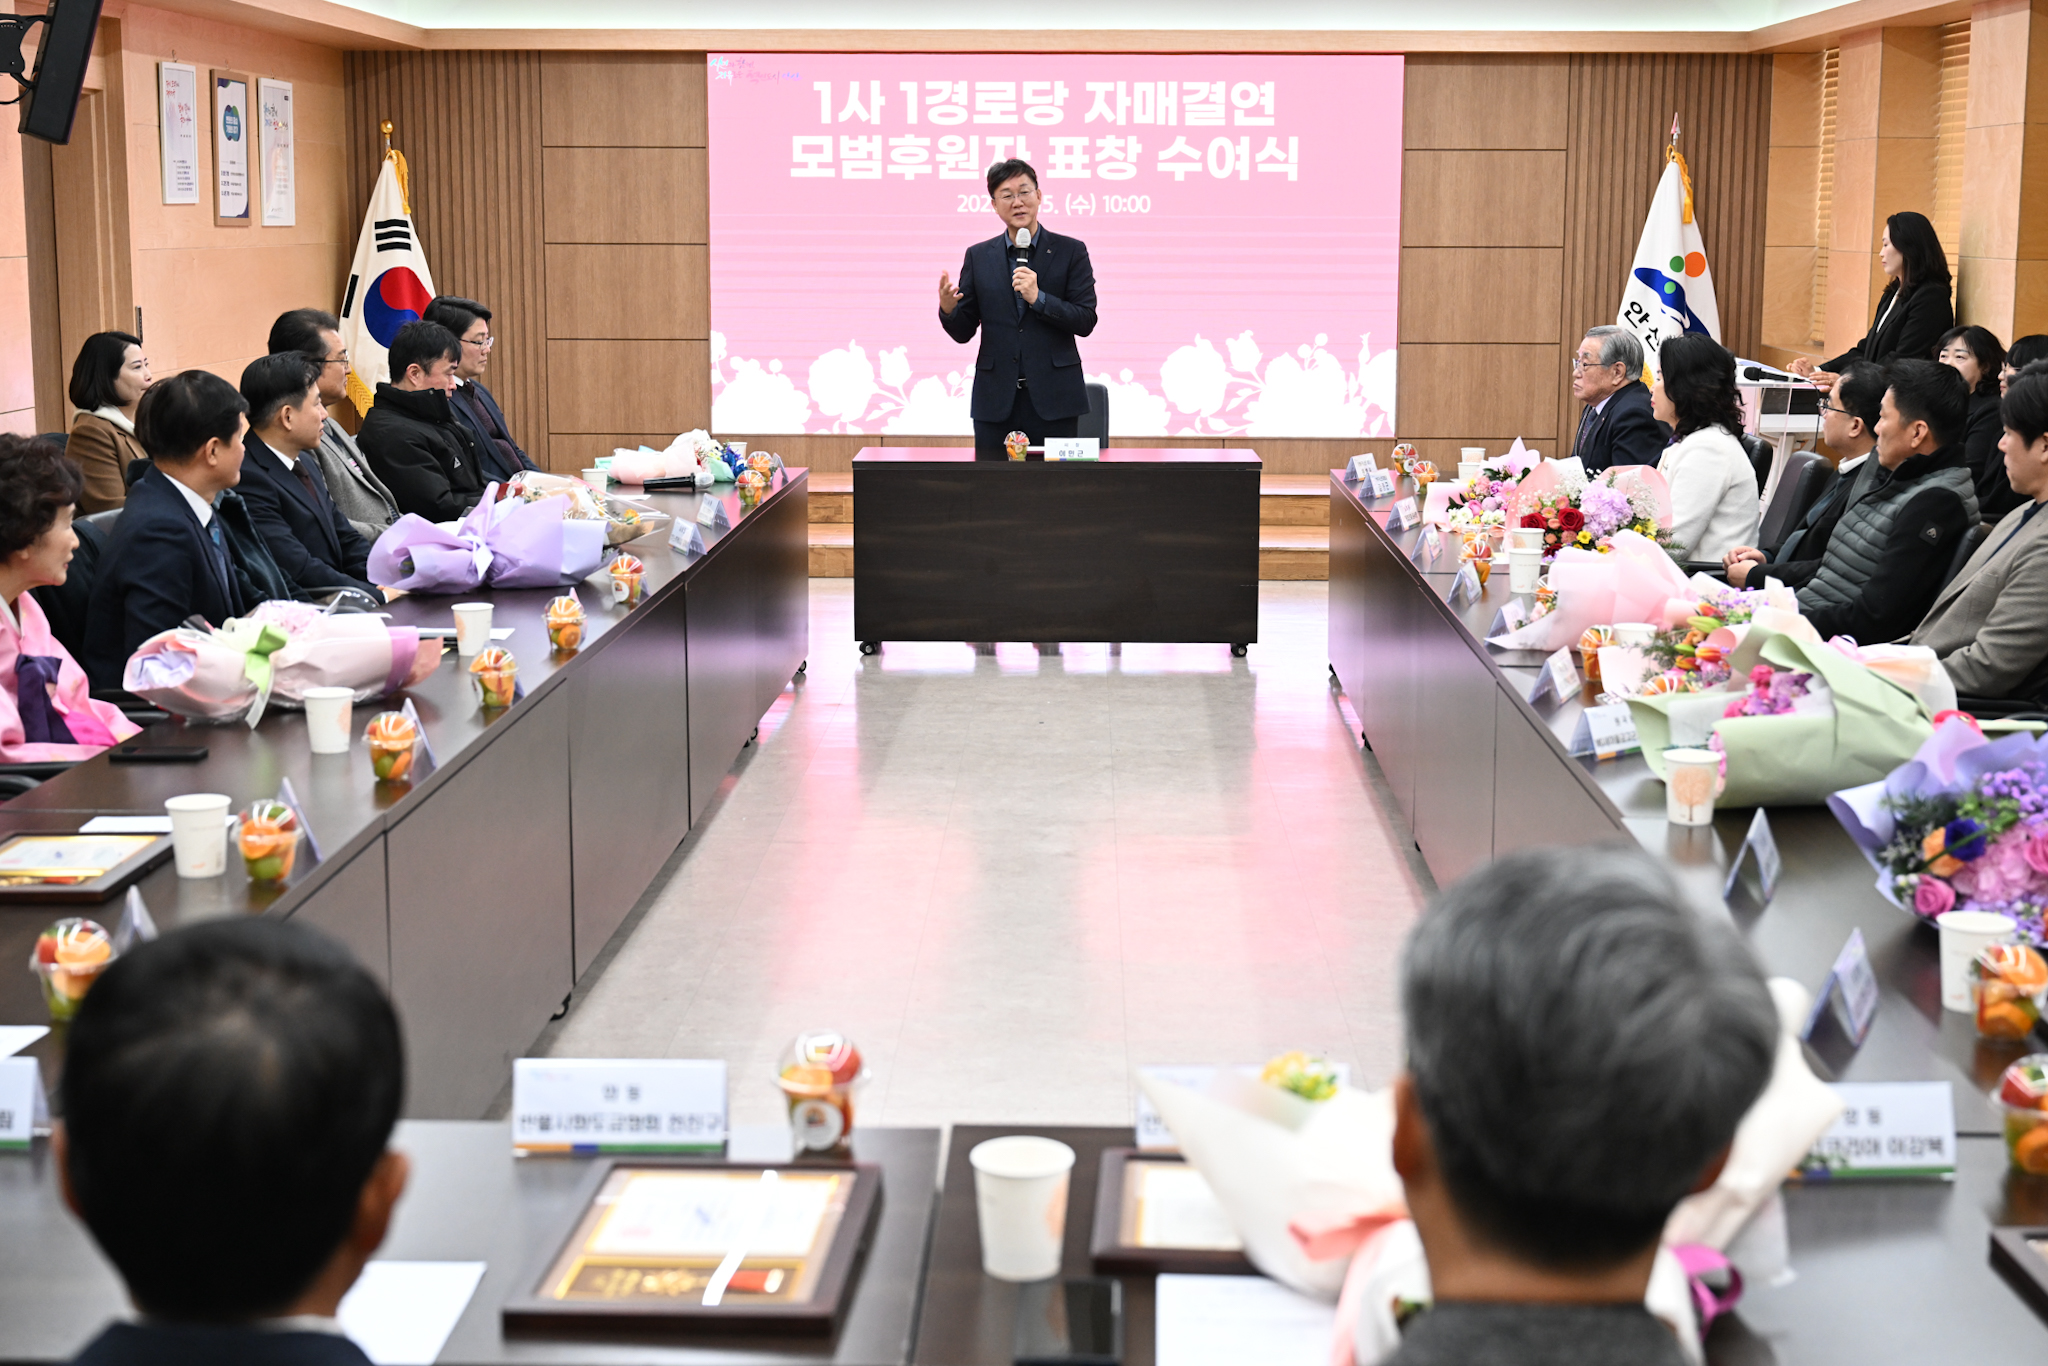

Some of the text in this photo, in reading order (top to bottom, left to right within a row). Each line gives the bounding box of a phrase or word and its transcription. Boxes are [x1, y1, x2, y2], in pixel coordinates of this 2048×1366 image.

[813, 80, 1275, 127] 1사 1경로당 자매결연
[1046, 134, 1143, 181] 표창
[1157, 135, 1299, 182] 수여식
[957, 194, 996, 213] 202
[1065, 193, 1096, 216] (수)
[1102, 194, 1151, 214] 10:00
